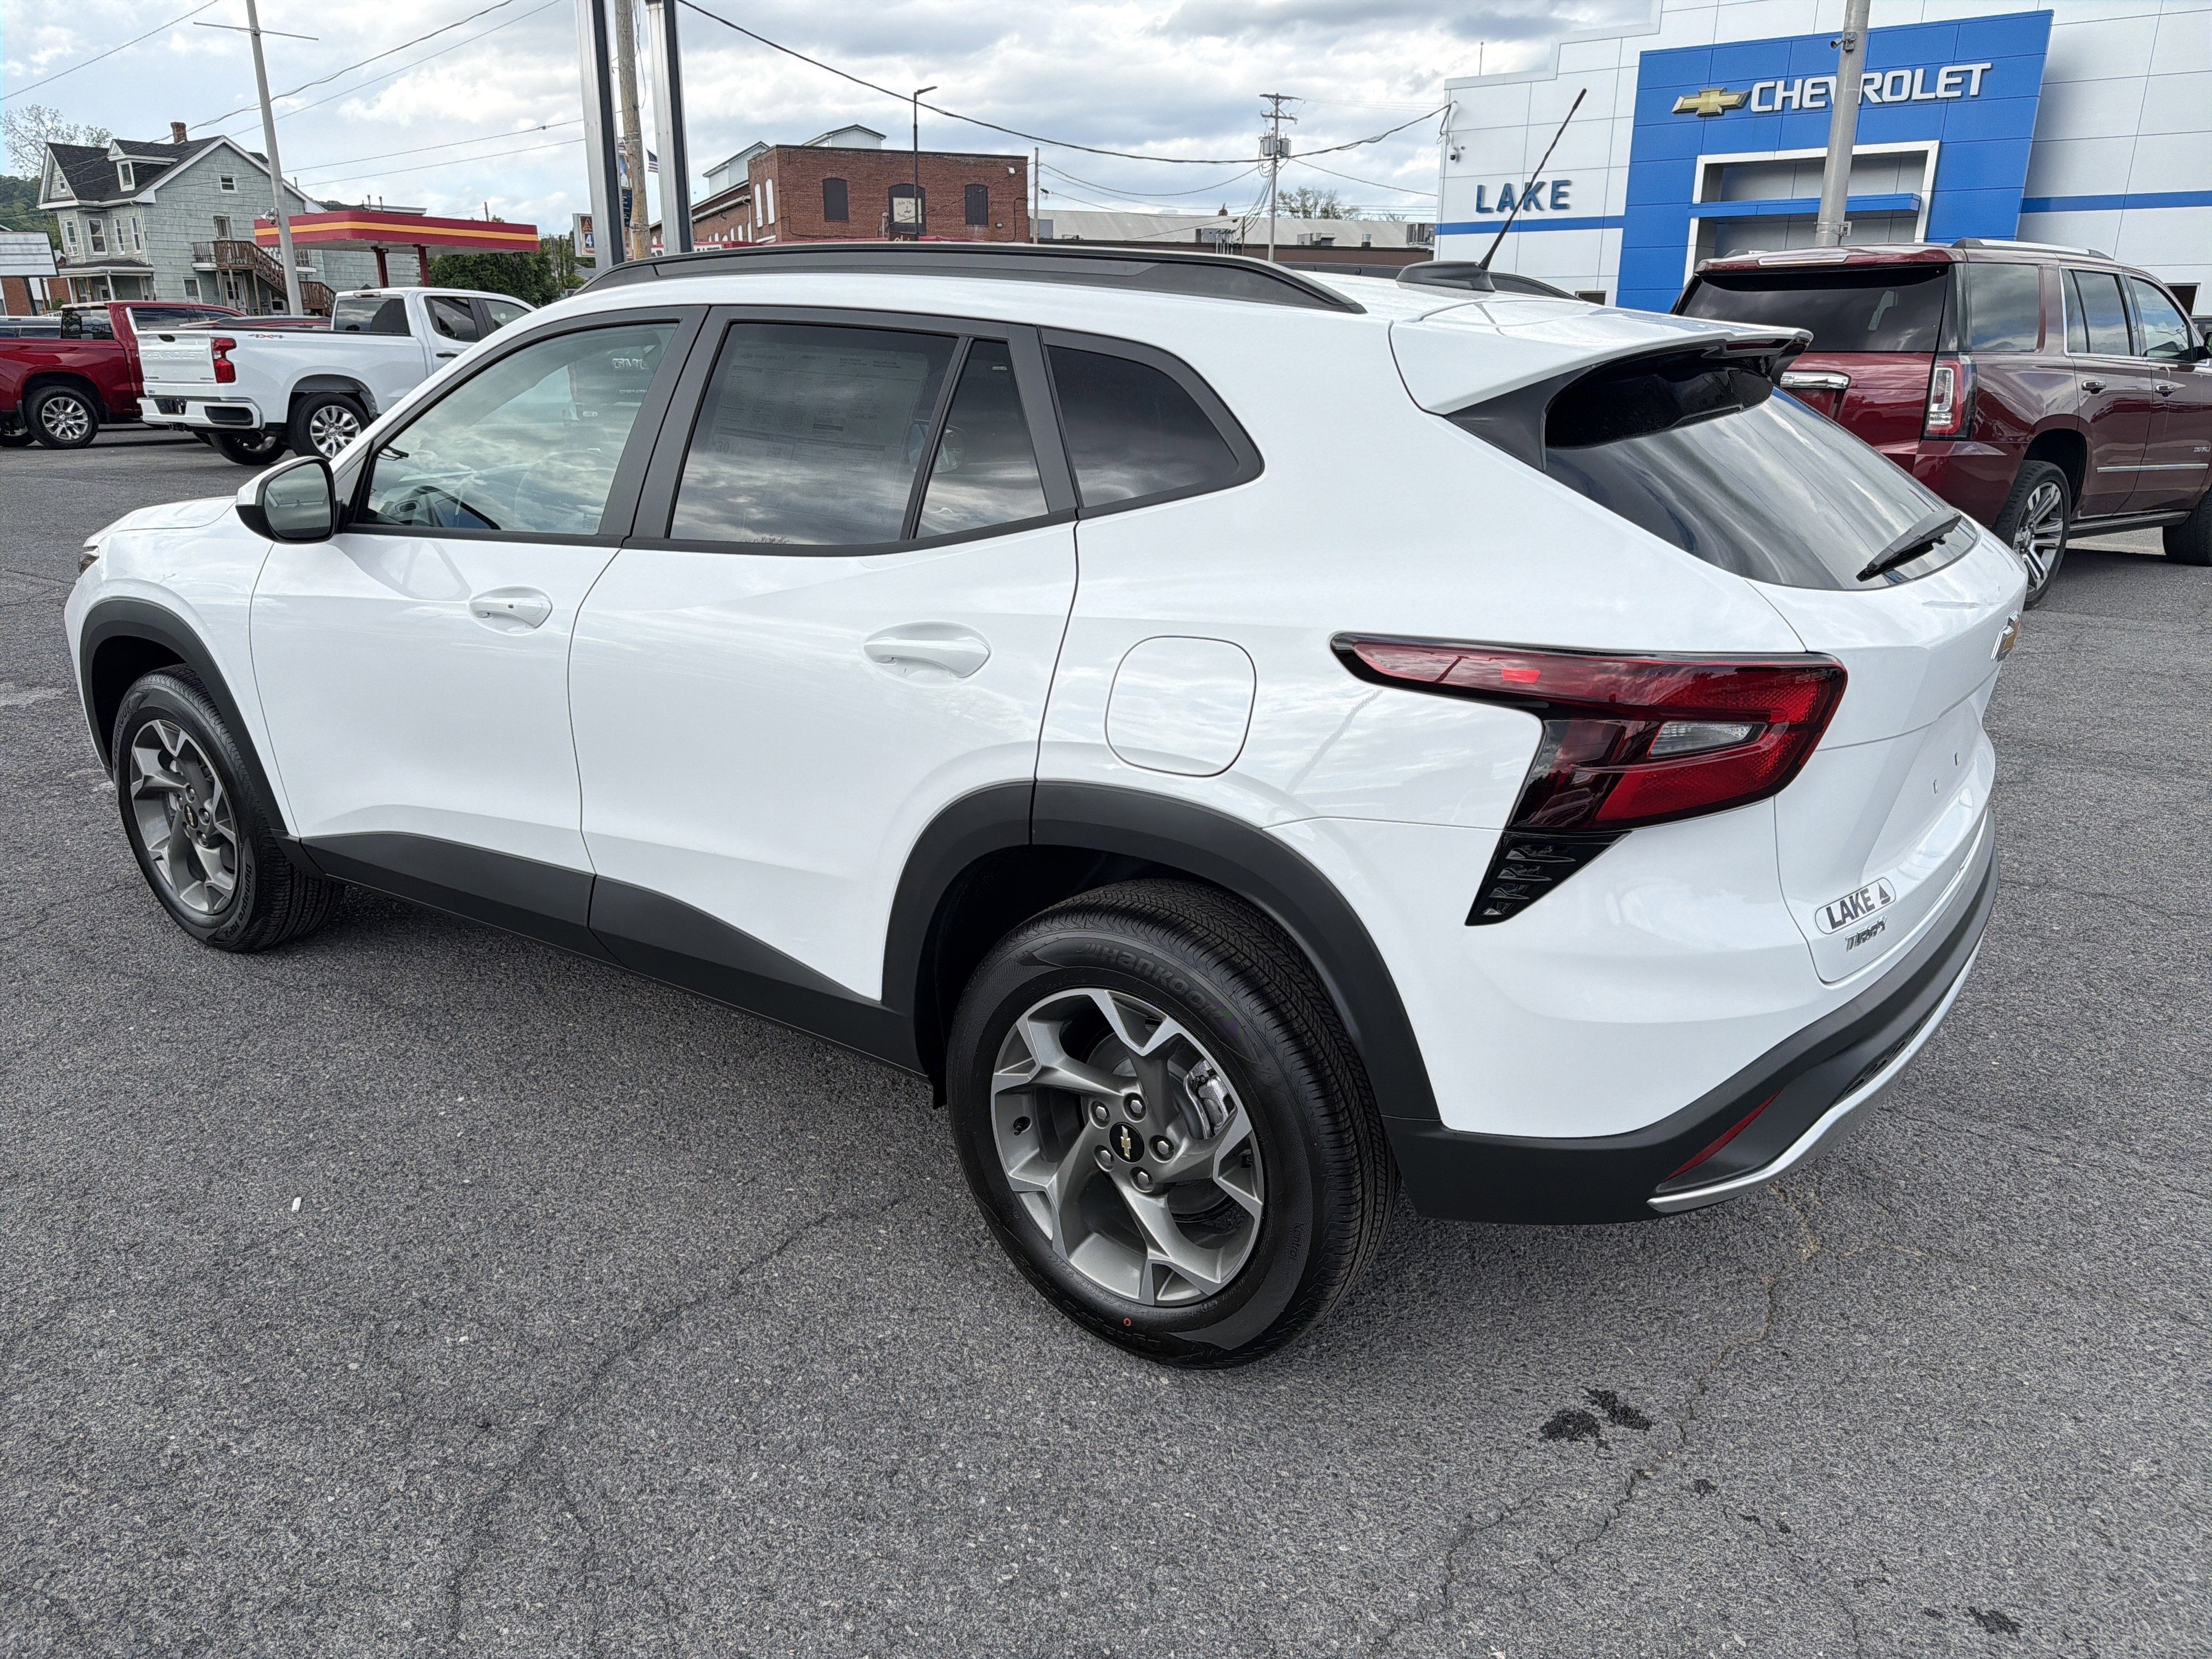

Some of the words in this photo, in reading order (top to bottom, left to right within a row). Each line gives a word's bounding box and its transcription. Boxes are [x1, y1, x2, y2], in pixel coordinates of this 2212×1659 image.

[1476, 179, 1572, 213] LAKE
[612, 358, 649, 370] GMC
[1826, 887, 1875, 929] LAKE
